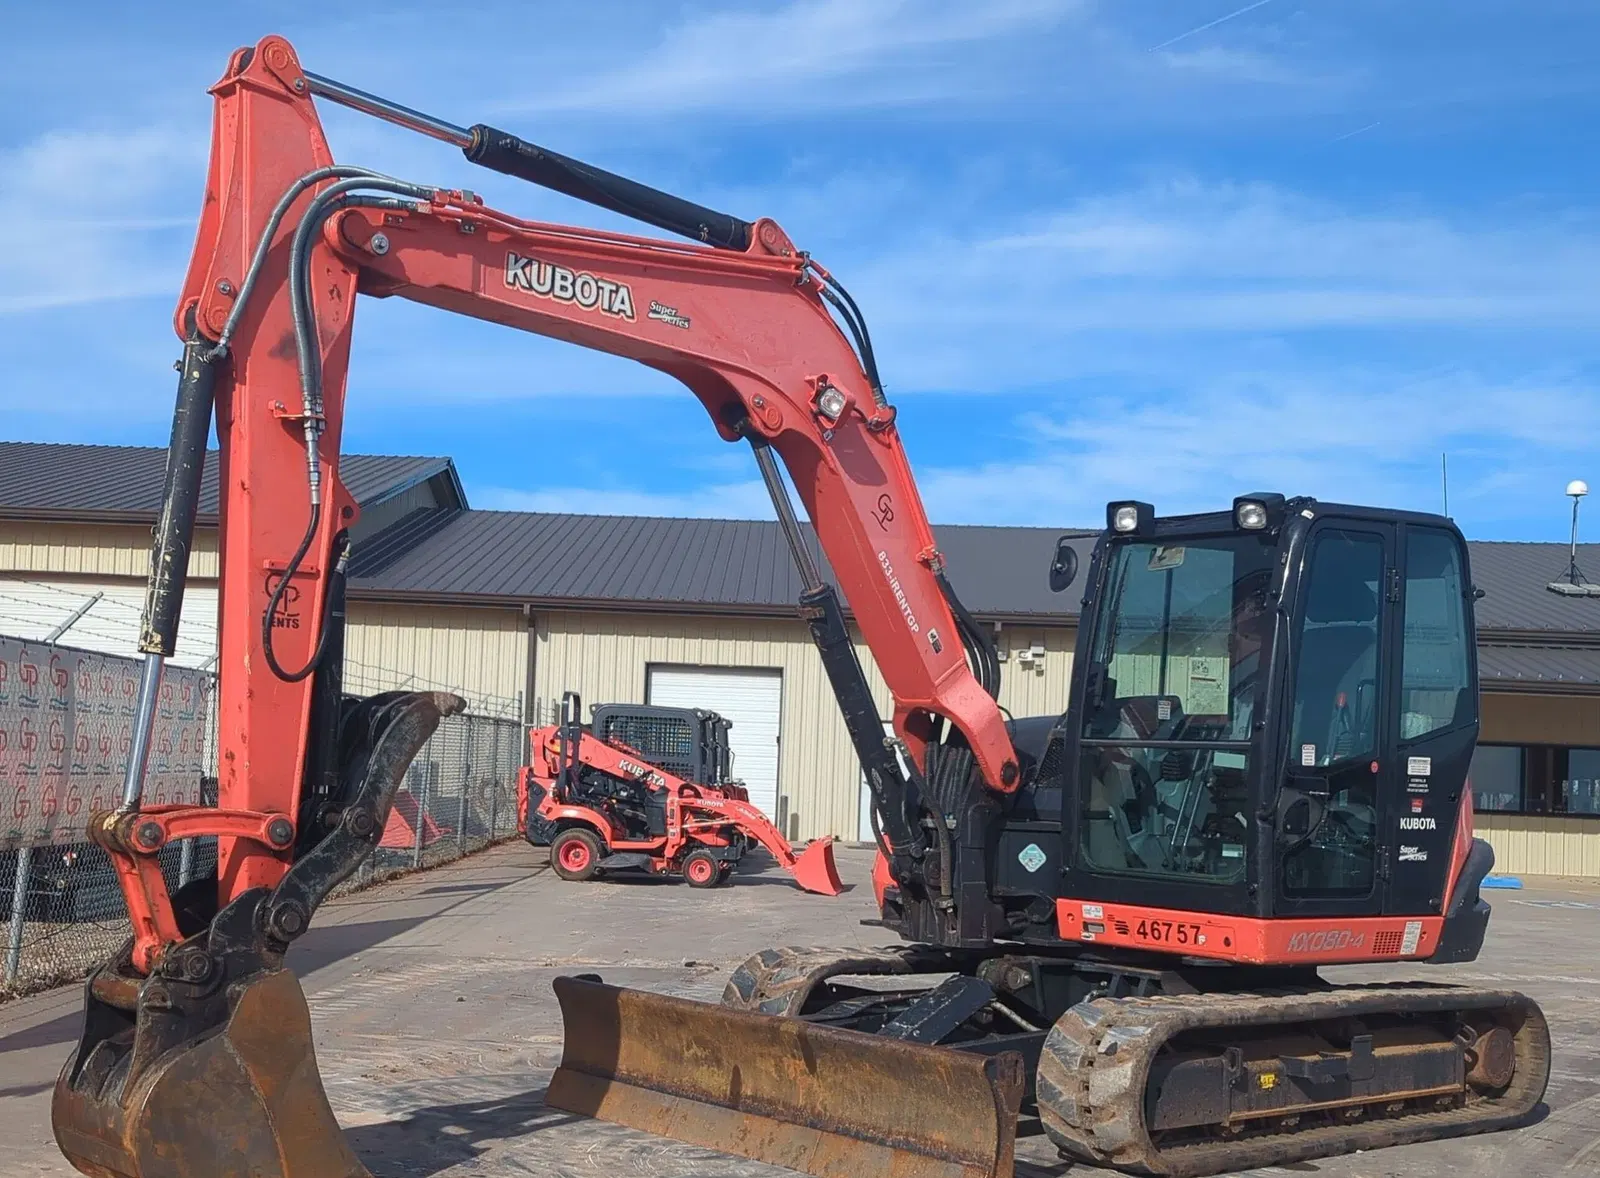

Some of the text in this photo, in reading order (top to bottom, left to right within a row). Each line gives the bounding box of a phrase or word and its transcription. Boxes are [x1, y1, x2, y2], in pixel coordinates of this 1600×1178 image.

[505, 251, 636, 321] KUBOTA
[649, 301, 677, 316] Super
[661, 313, 689, 328] Series
[877, 551, 919, 633] 833-iRENTGP
[1399, 817, 1436, 830] KUBOTA
[1137, 919, 1200, 945] 46757
